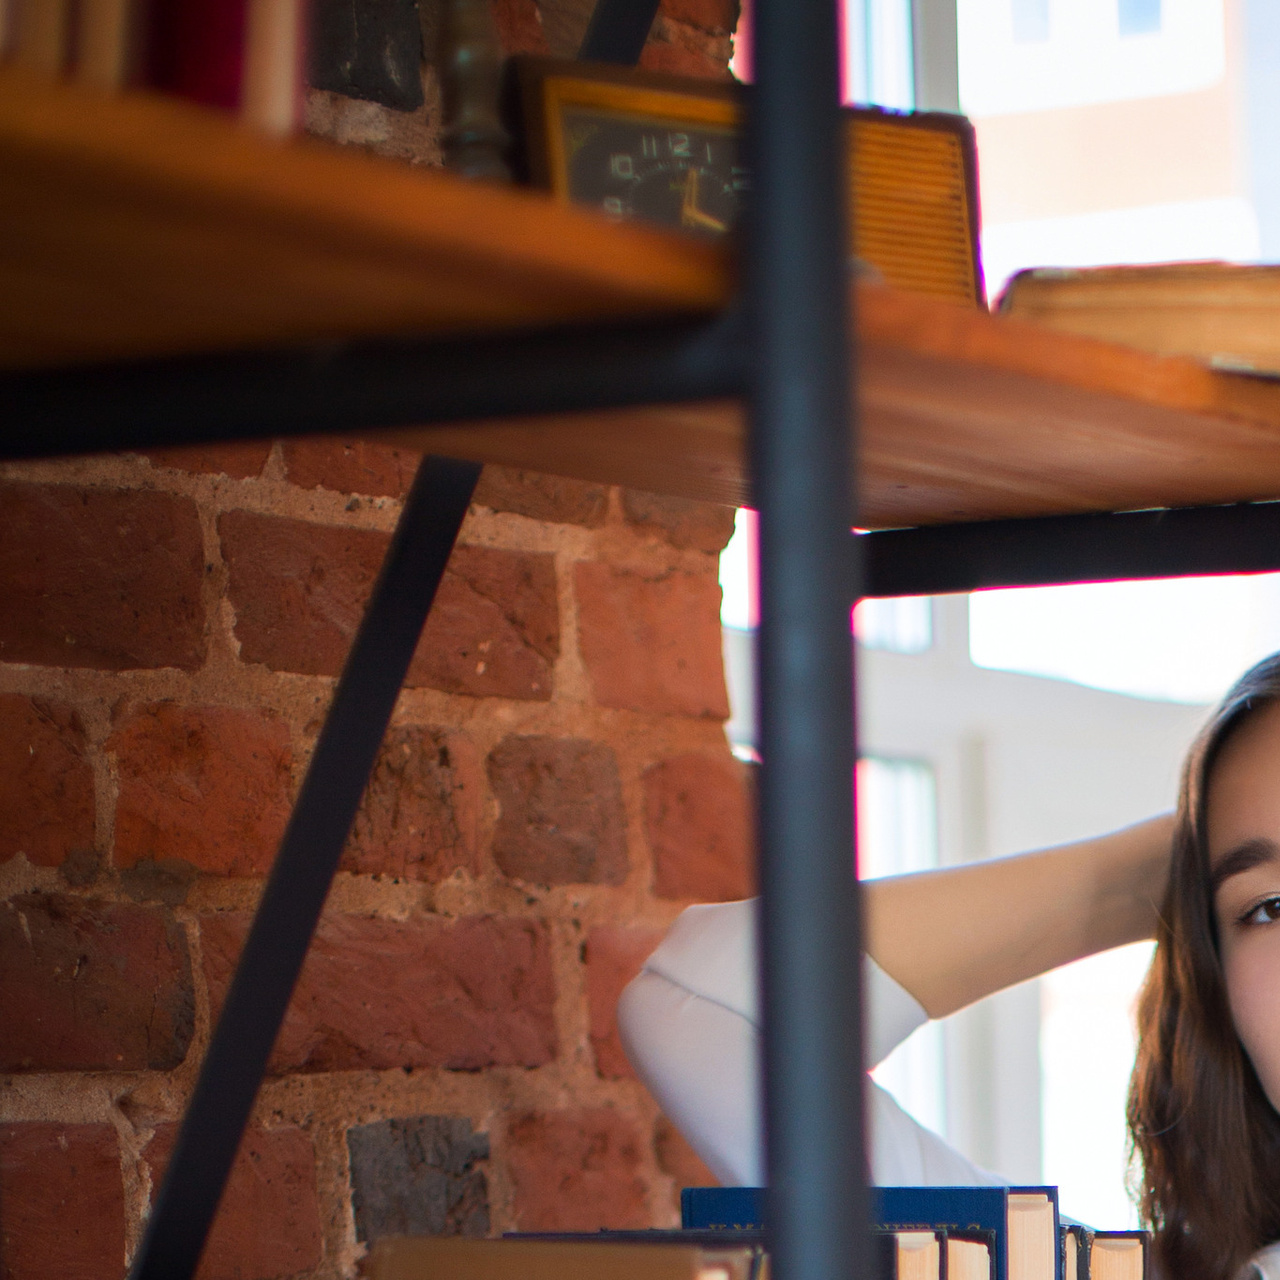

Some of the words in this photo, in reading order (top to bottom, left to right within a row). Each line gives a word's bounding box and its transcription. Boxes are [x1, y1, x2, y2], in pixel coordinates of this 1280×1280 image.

[641, 134, 658, 158] 11
[668, 131, 694, 158] 12
[610, 154, 633, 180] 10
